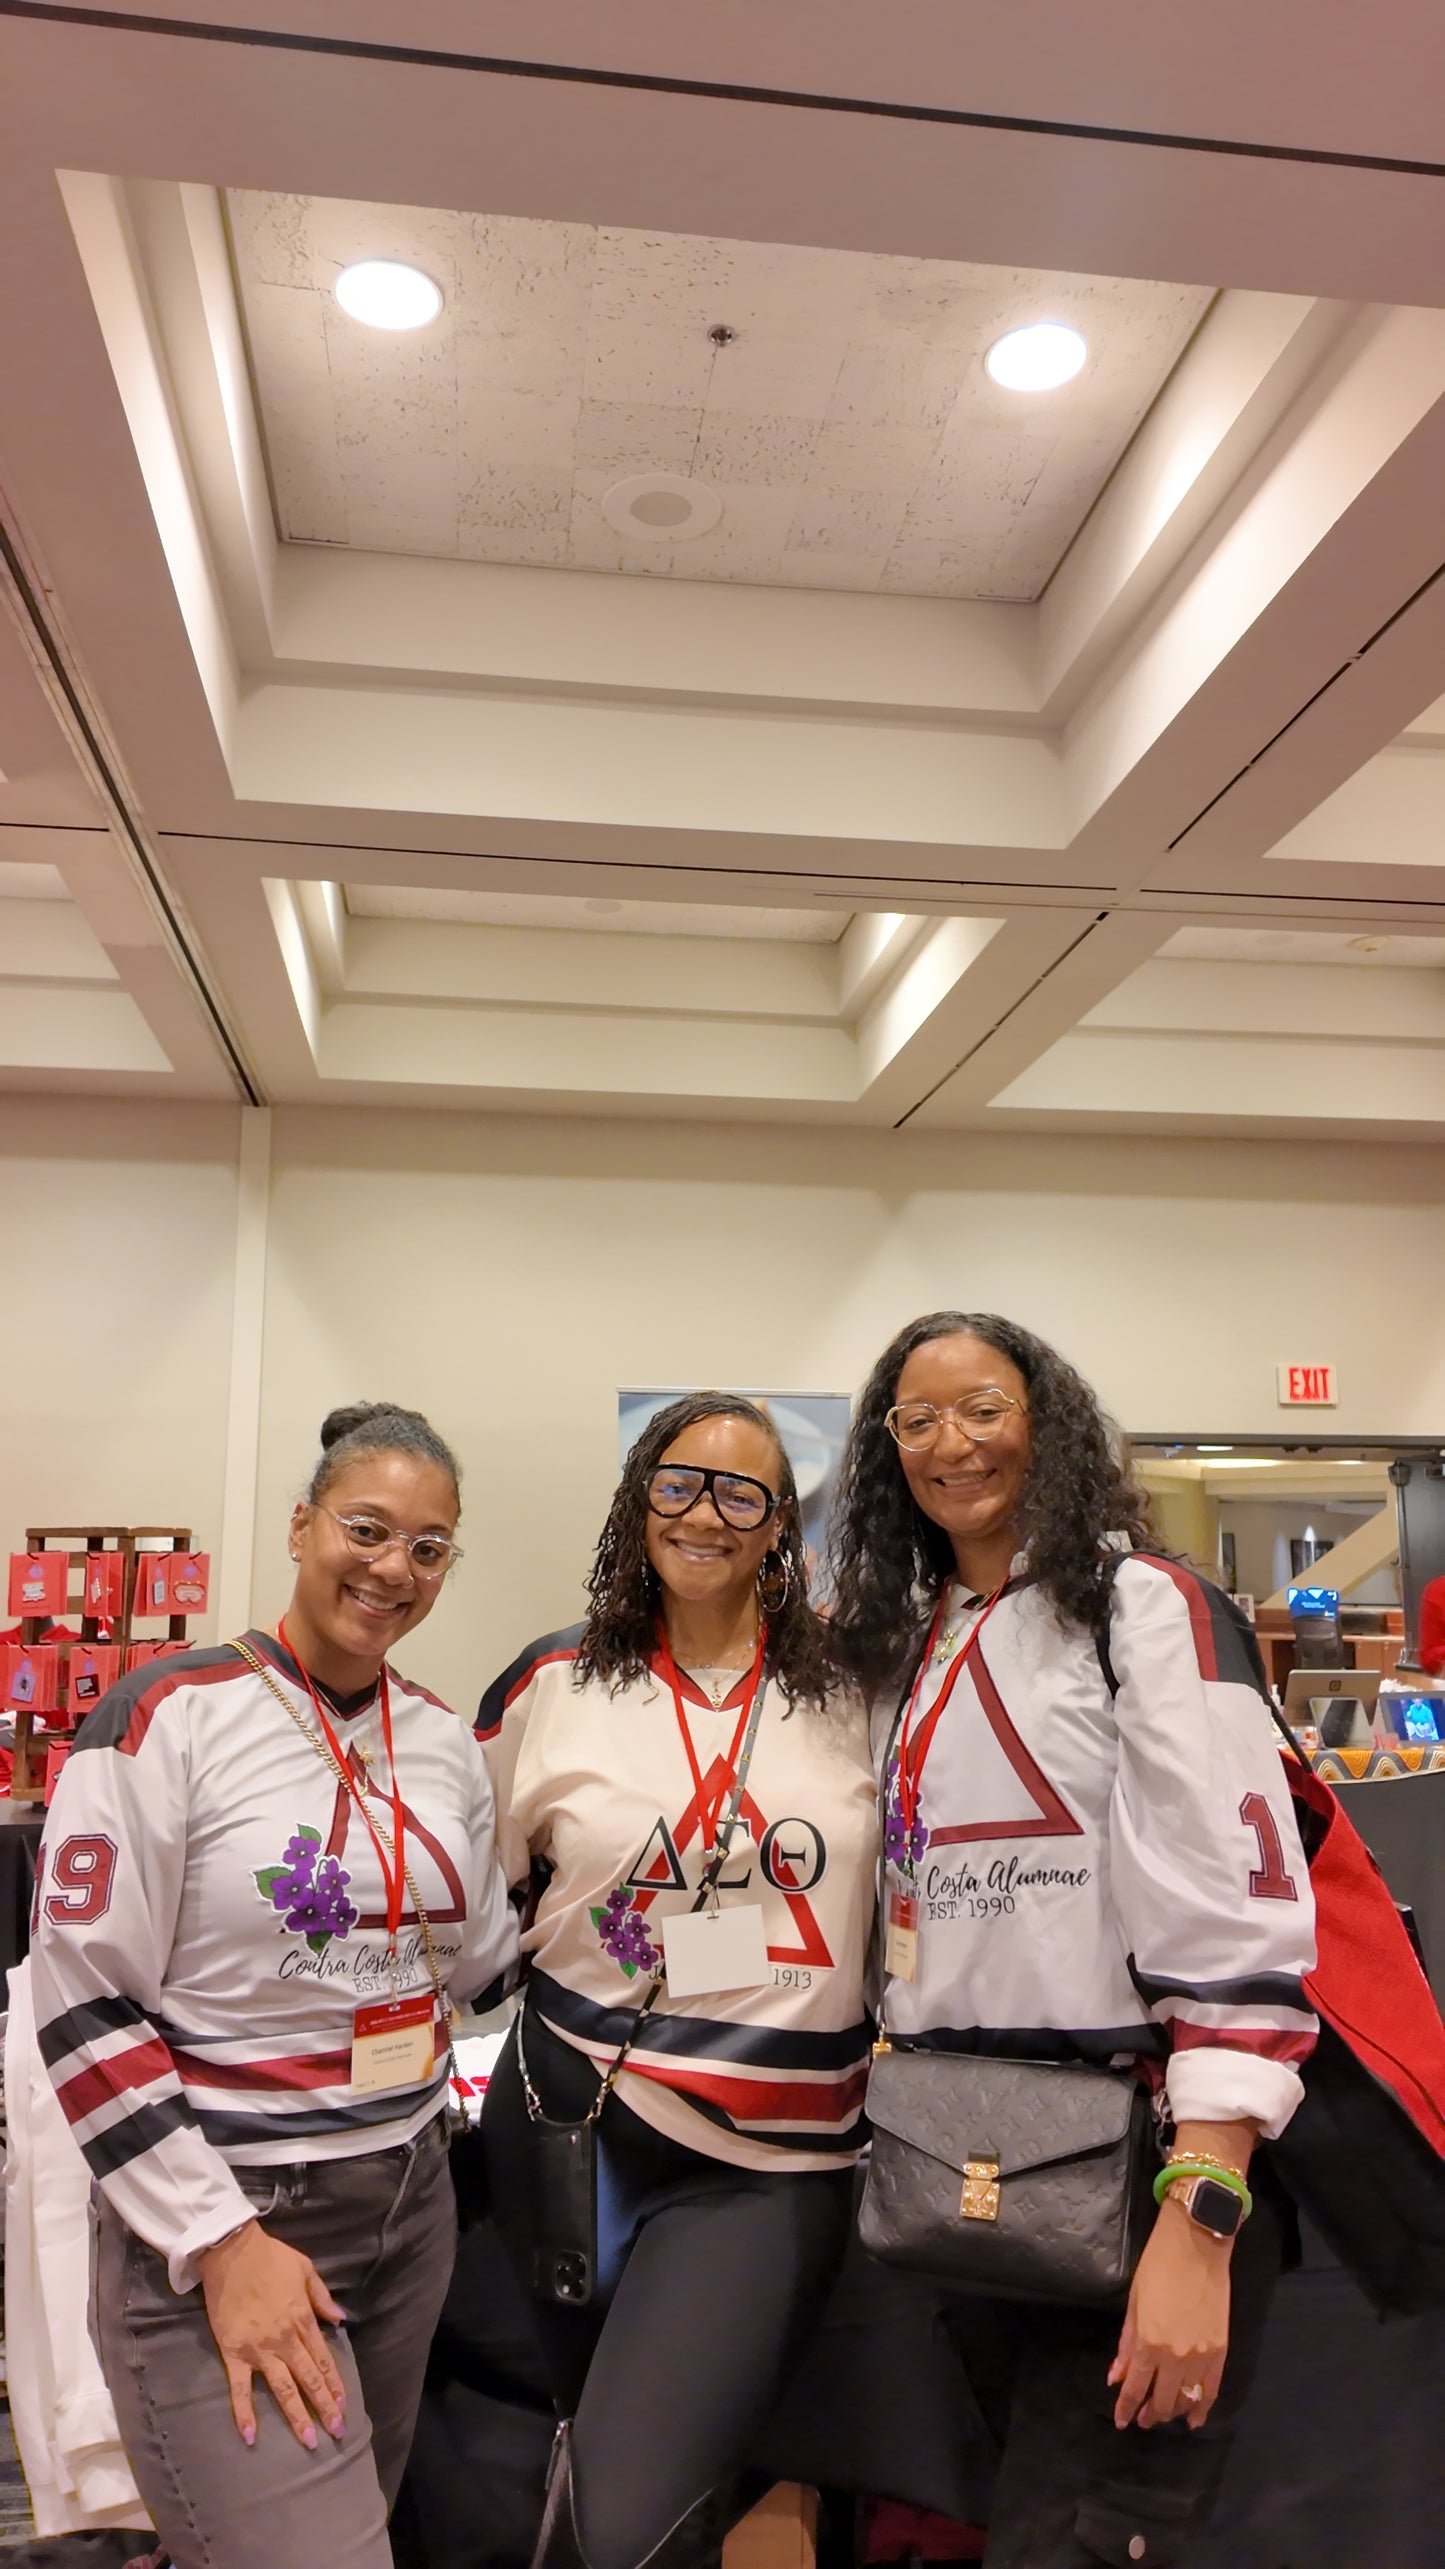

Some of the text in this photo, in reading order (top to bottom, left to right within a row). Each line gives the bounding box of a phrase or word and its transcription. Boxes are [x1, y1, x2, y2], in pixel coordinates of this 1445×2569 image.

[1289, 1367, 1329, 1401] EXIT
[1239, 1791, 1298, 1902] 1
[32, 1833, 118, 1935] 9
[926, 1862, 982, 1900] Costa
[987, 1856, 1092, 1895] Alumnae
[927, 1901, 961, 1921] EST.
[968, 1896, 1016, 1919] 1990
[278, 1947, 349, 1980] Contra
[352, 1967, 418, 1993] EST. 990
[773, 1968, 812, 1990] 1913
